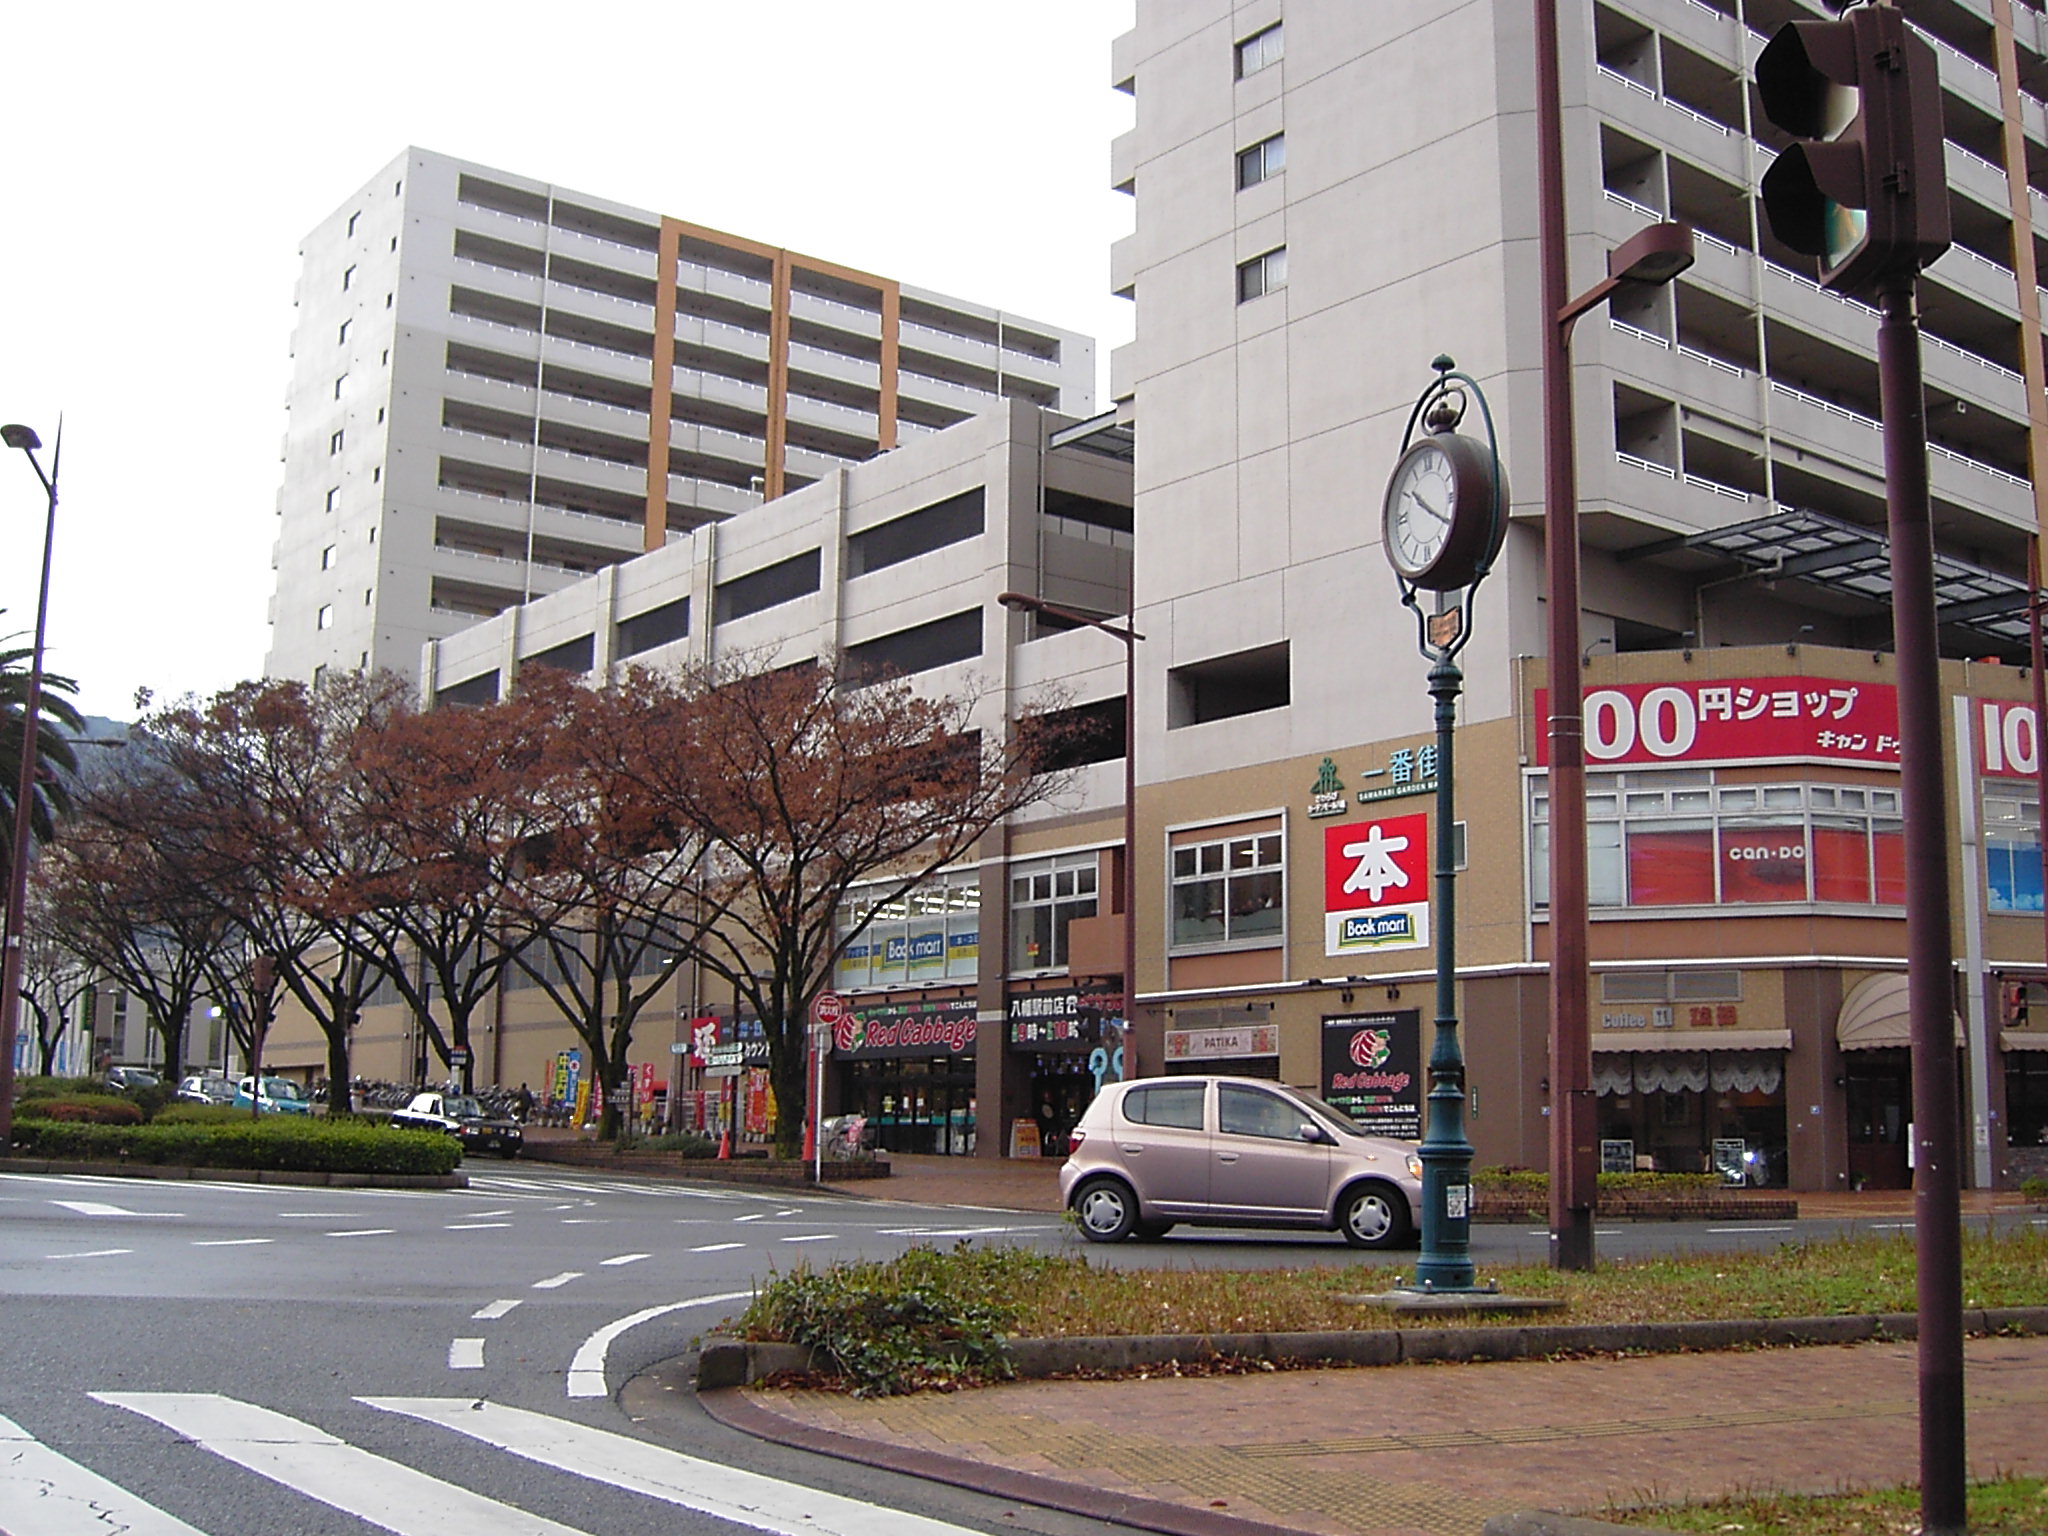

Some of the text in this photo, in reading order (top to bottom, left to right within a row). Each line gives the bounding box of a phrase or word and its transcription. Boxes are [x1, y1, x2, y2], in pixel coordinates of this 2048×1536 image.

[1583, 687, 1857, 760] 00円ショップ
[1817, 730, 1867, 751] キャン
[1983, 704, 2038, 773] 10
[1360, 744, 1438, 785] 一番街
[1396, 783, 1426, 795] GARDEN
[1342, 825, 1409, 902] 本
[1346, 917, 1406, 936] Book mart
[1010, 995, 1065, 1018] 八幡駅前店
[1602, 1013, 1646, 1028] Coffee
[865, 1016, 977, 1051] Red Cabbage
[1204, 1036, 1238, 1048] PATIKA
[744, 1041, 770, 1056] カウント
[1332, 1071, 1410, 1093] Red Cabbage
